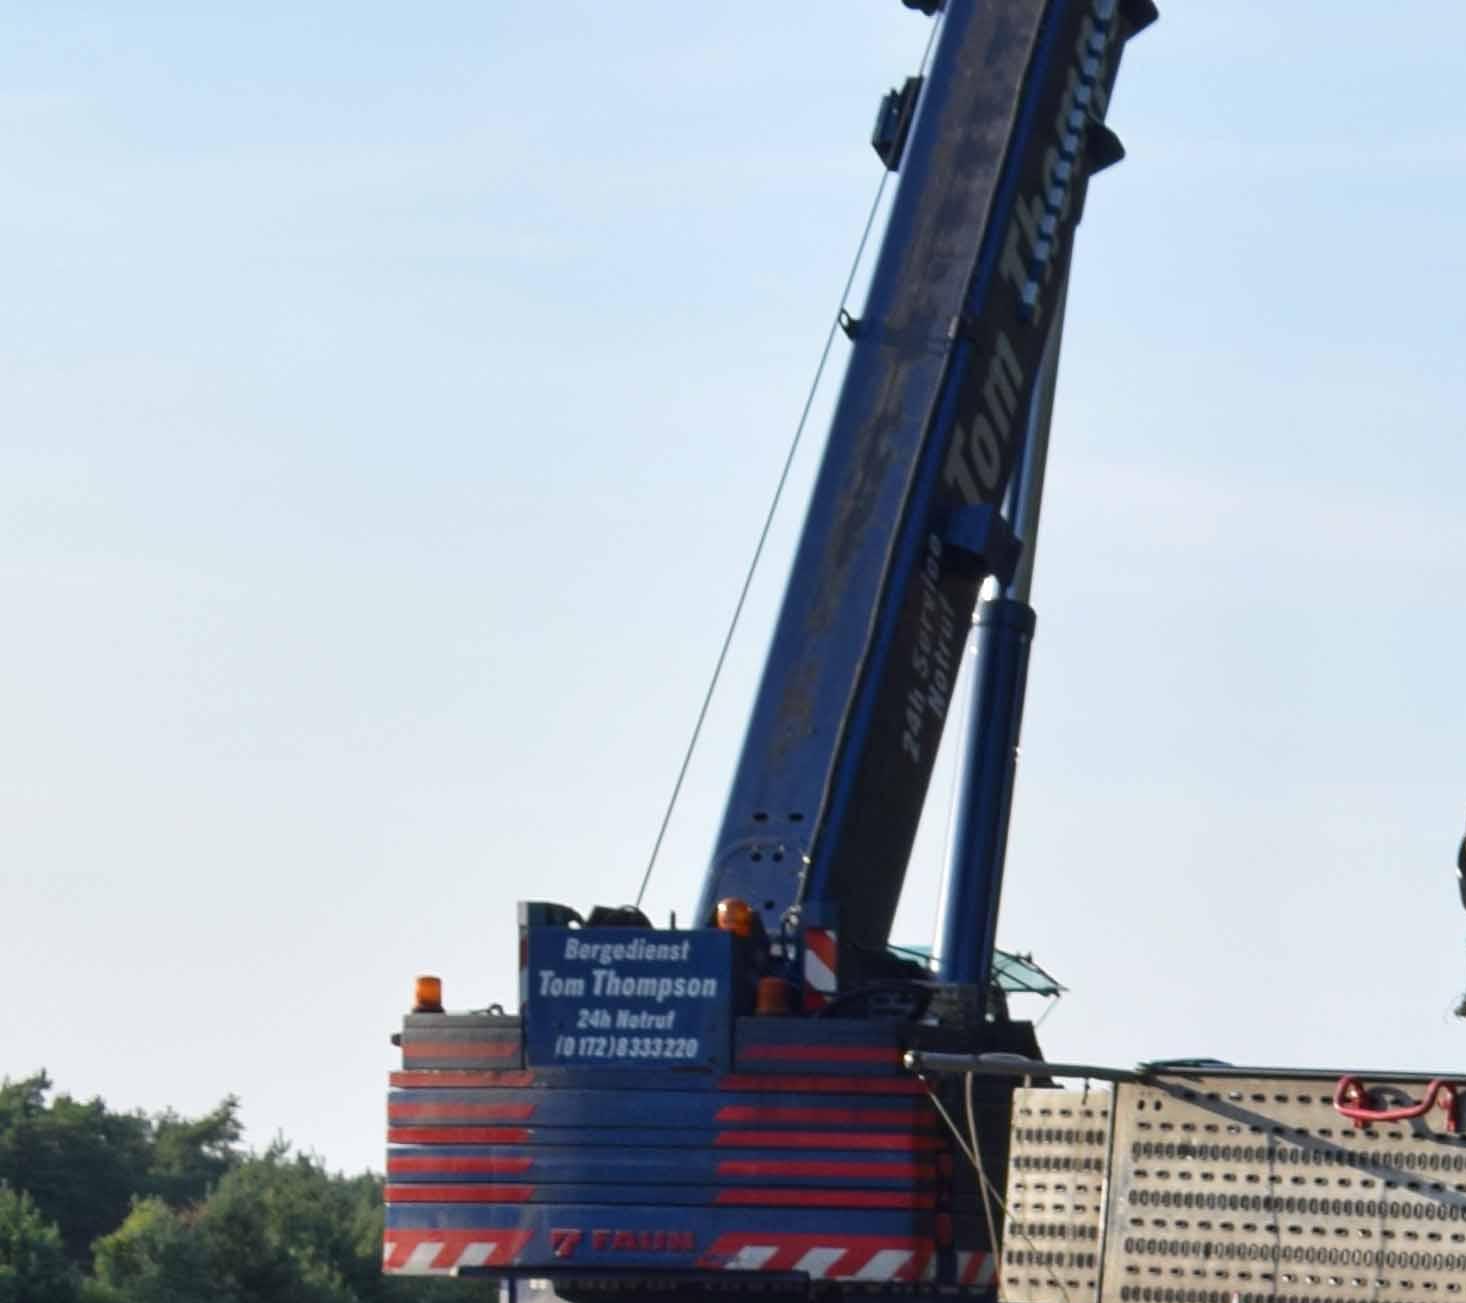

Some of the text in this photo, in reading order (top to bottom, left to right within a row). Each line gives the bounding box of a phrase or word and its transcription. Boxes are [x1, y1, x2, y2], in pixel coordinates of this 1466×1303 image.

[946, 331, 1026, 503] Tom
[564, 937, 691, 965] Bergedienst
[539, 968, 717, 1003] Tom Thompson
[576, 1008, 676, 1029] 24h Notruf
